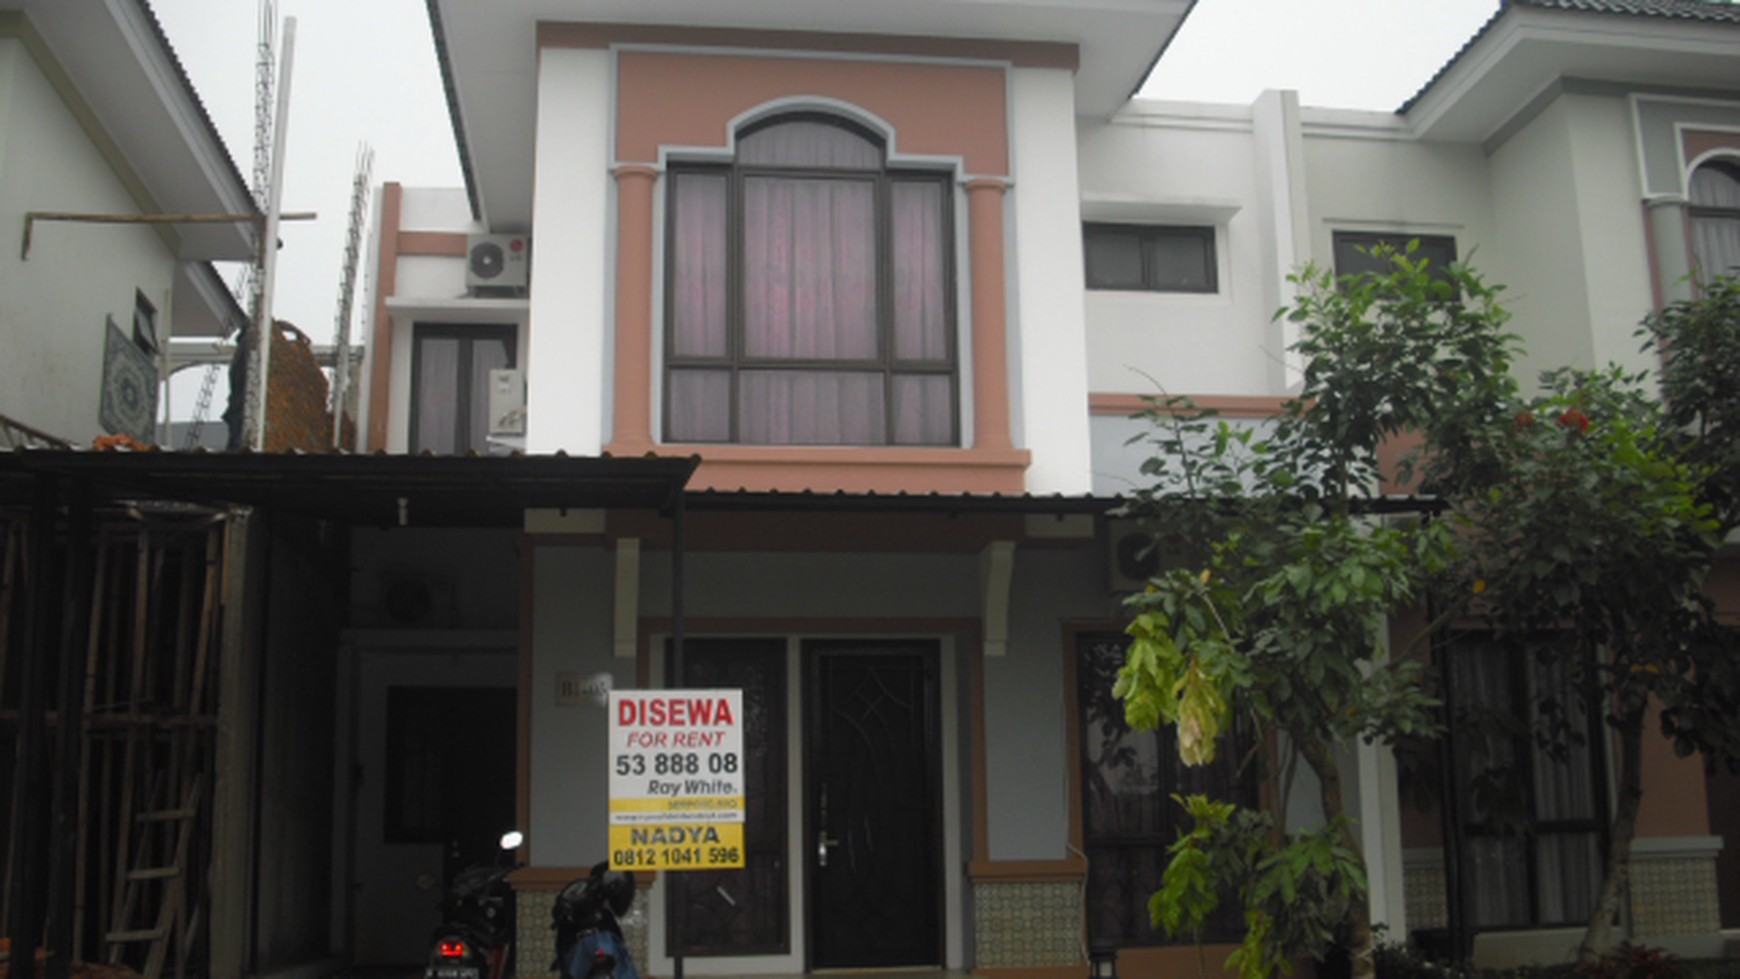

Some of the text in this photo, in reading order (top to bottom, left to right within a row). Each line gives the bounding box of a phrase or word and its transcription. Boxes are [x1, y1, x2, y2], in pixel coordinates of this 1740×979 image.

[618, 698, 734, 727] DISEWA
[626, 730, 726, 748] FOR RENT
[616, 752, 738, 776] 53 888 08
[647, 780, 682, 797] Ray
[630, 826, 721, 846] NADYA
[613, 846, 740, 867] 0812 1041 596
